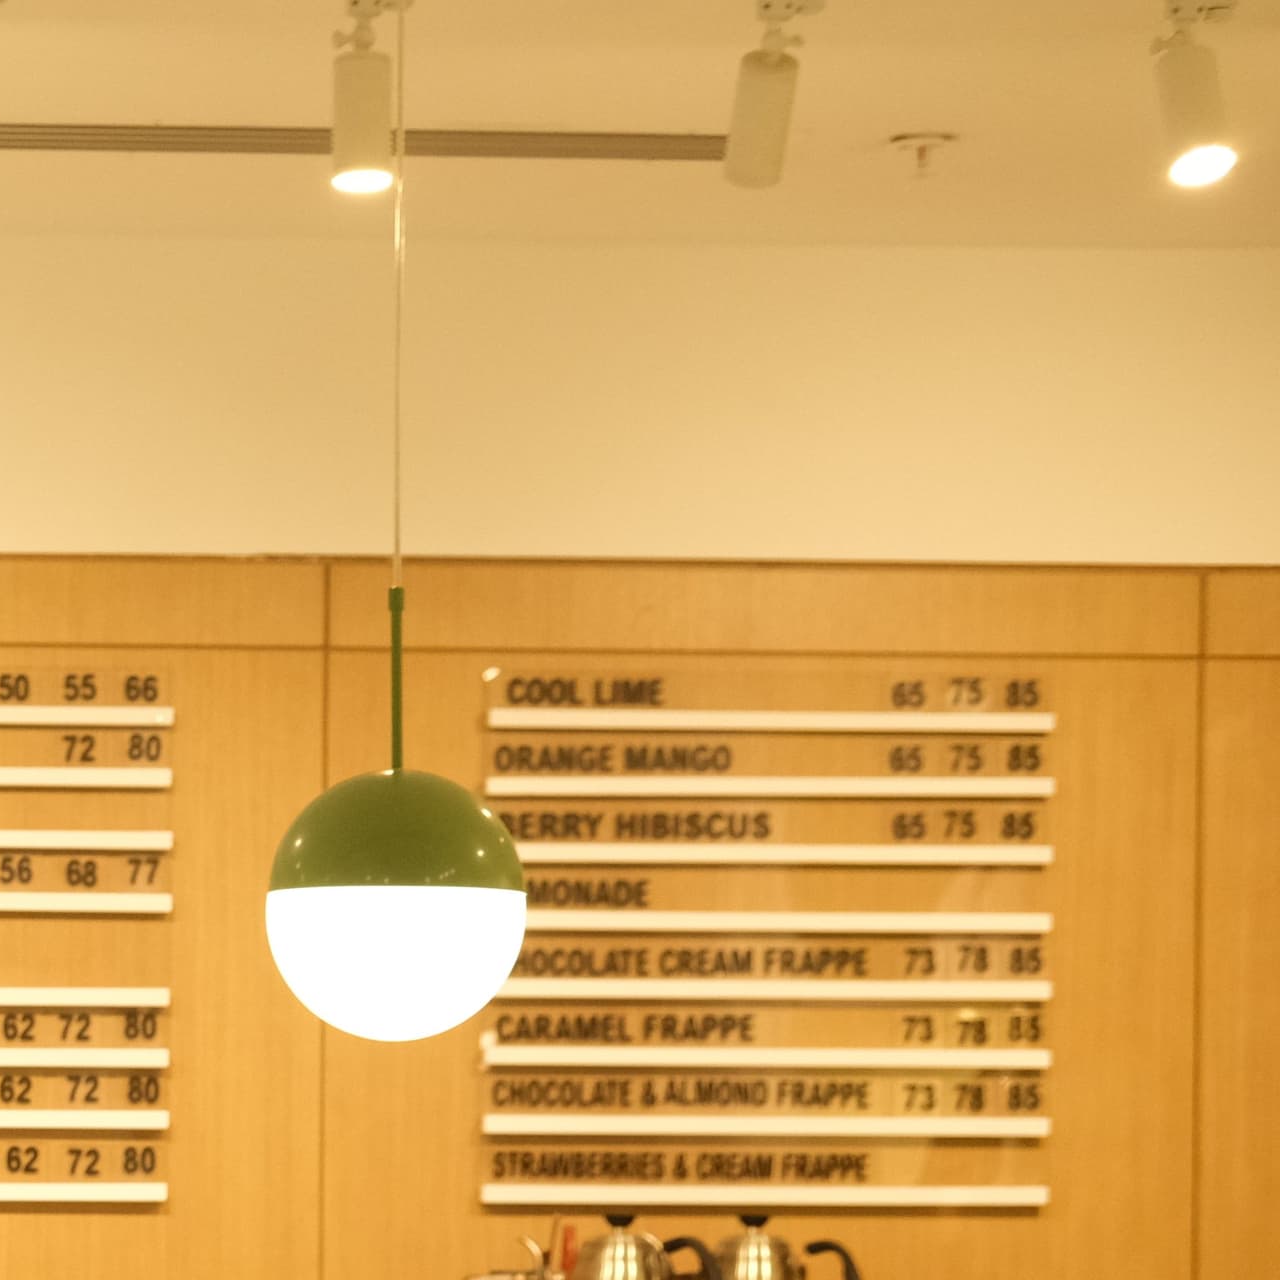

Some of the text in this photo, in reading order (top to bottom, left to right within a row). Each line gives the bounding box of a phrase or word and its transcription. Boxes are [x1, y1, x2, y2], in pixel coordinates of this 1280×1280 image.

[0, 676, 29, 701] 50
[64, 675, 96, 701] 55
[125, 676, 158, 702] 66
[507, 677, 1038, 707] COOL LIME 65 75 85
[64, 736, 96, 762] 72
[128, 735, 161, 761] 80
[495, 745, 613, 773] ORANGE
[624, 746, 731, 774] MANGO
[890, 746, 922, 772] 65
[950, 745, 983, 772] 75
[499, 813, 602, 840] BERRY
[616, 814, 771, 840] HIBISCUS
[892, 815, 925, 841] 65
[944, 811, 975, 838] 75
[1, 855, 31, 883] 56
[66, 862, 97, 887] 68
[128, 856, 160, 883] 77
[528, 880, 648, 907] MONADE
[513, 948, 649, 976] HOCOLATE
[659, 949, 751, 976] CREAM
[764, 949, 867, 976] FRAPPE
[904, 948, 935, 975] 73
[958, 945, 988, 972] 78
[3, 1014, 35, 1040] 62
[59, 1014, 91, 1040] 72
[125, 1013, 157, 1039] 80
[497, 1015, 632, 1042] CARAMEL
[643, 1015, 752, 1042] FRAPPE
[903, 1016, 933, 1042] 73
[0, 1077, 32, 1103] 62
[66, 1077, 98, 1103] 72
[128, 1075, 160, 1102] 80
[493, 1080, 631, 1107] CHOCOLATE
[663, 1079, 768, 1107] ALMOND
[776, 1081, 868, 1109] FRAPPE
[7, 1147, 38, 1173] 62
[67, 1149, 99, 1175] 72
[124, 1147, 156, 1173] 80
[696, 1153, 773, 1179] CREAM
[781, 1153, 867, 1181] FRAPPE
